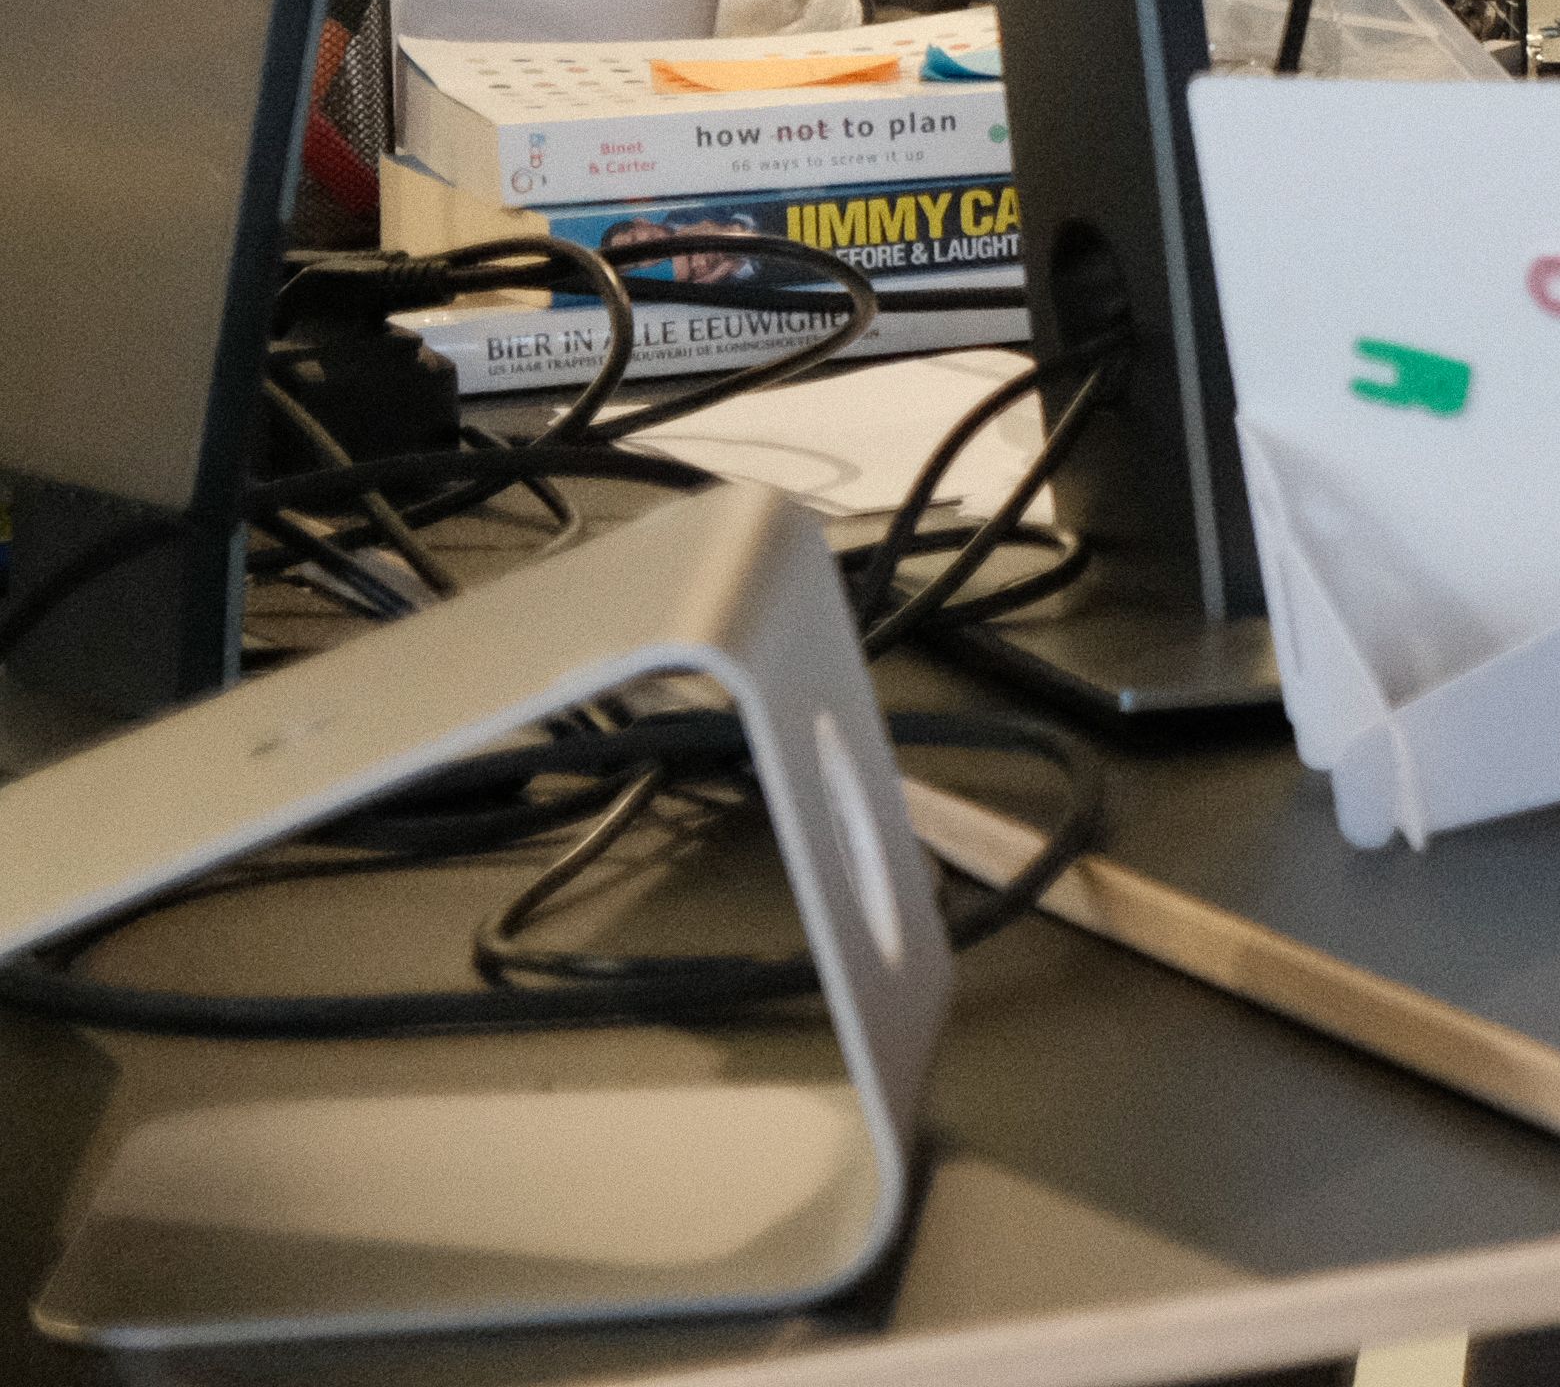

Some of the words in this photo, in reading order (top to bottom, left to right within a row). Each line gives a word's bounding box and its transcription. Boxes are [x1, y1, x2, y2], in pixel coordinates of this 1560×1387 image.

[697, 126, 761, 149] how
[777, 119, 830, 144] not
[842, 117, 874, 139] to
[889, 112, 957, 141] plan
[600, 141, 644, 156] Binet
[606, 158, 657, 173] Carter
[732, 160, 751, 172] 66
[760, 157, 799, 172] ways
[806, 156, 822, 168] to
[831, 153, 878, 167] screw
[885, 150, 897, 162] it
[905, 150, 924, 164] up
[836, 243, 906, 269] EFORE
[911, 242, 928, 266] &
[488, 333, 552, 360] BIER
[564, 328, 593, 353] IN
